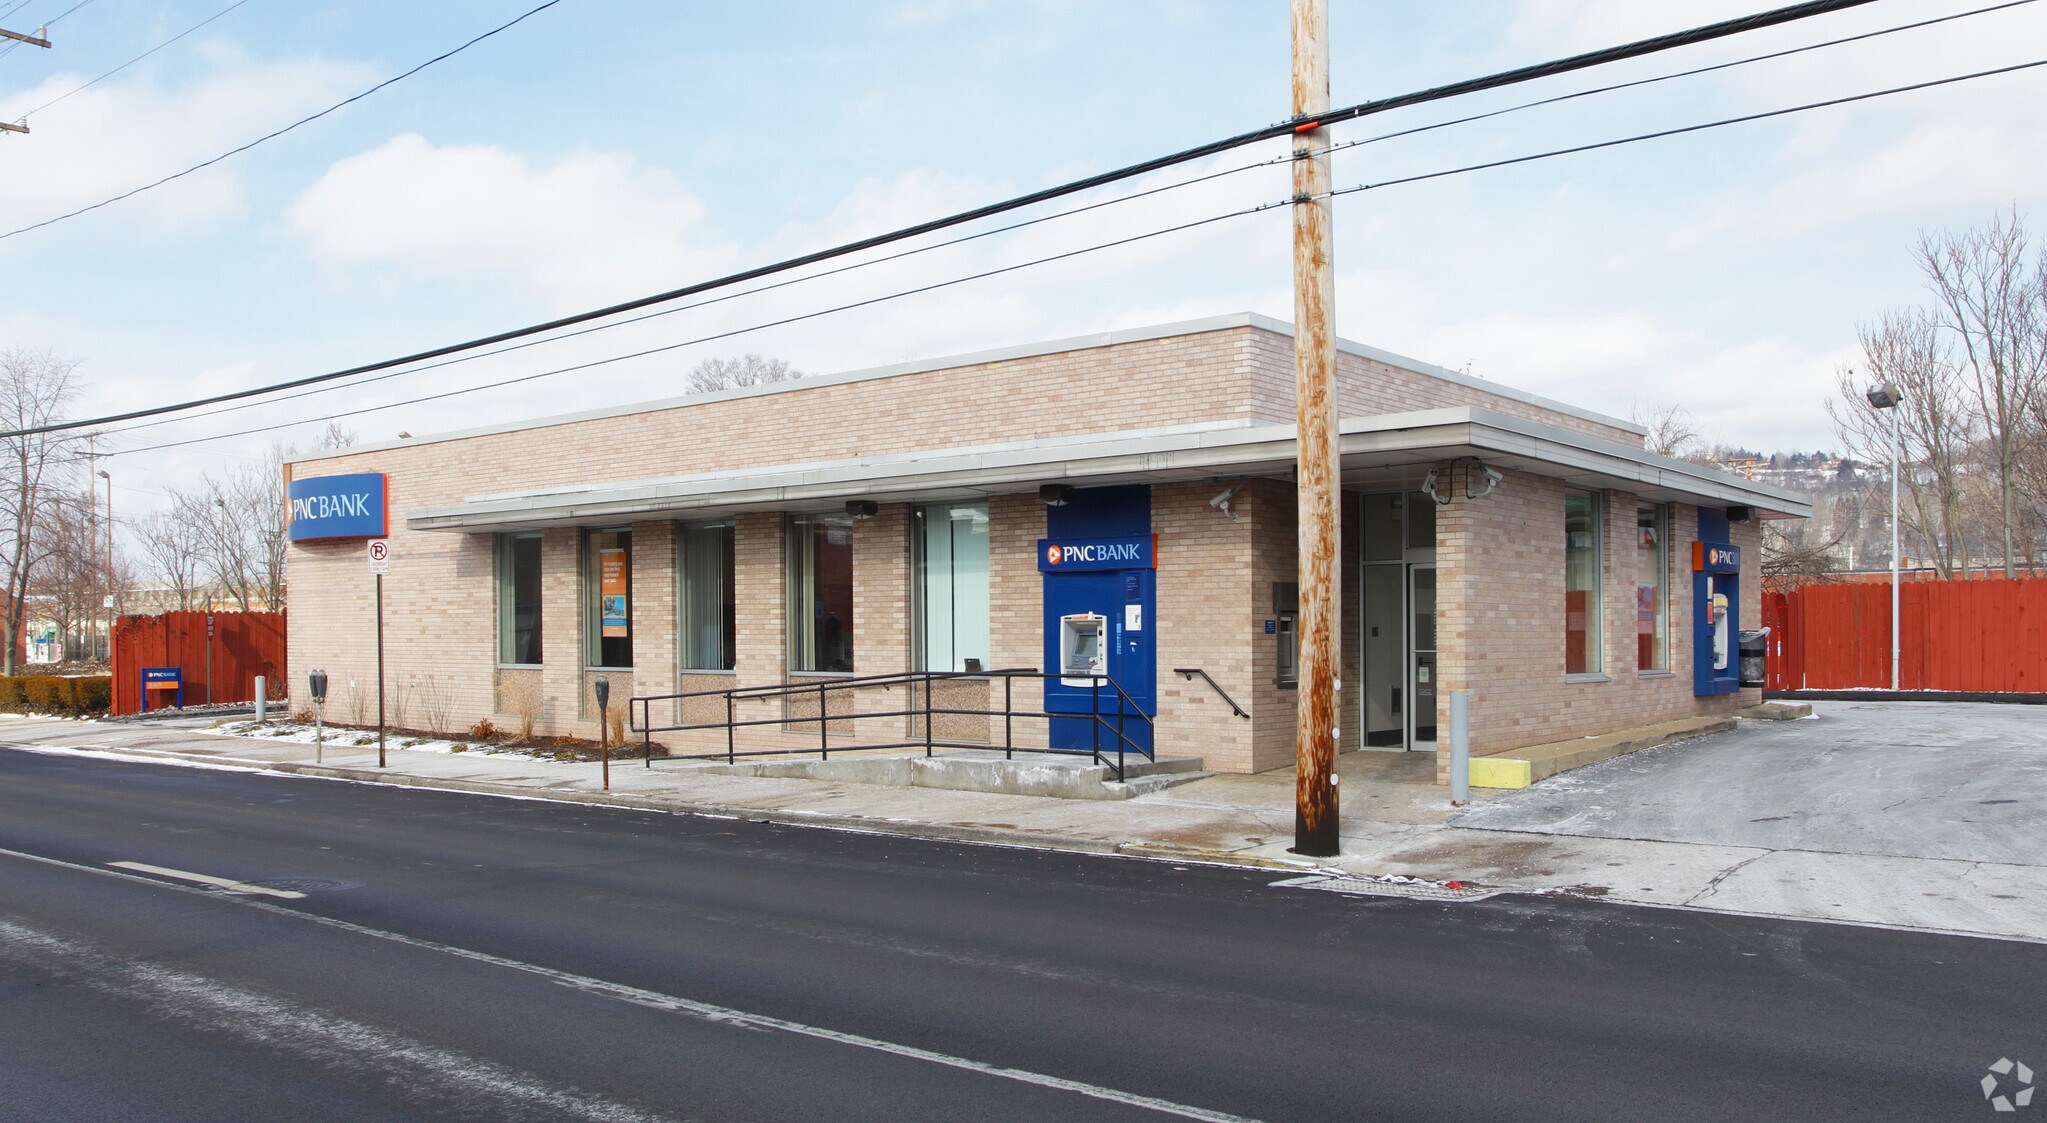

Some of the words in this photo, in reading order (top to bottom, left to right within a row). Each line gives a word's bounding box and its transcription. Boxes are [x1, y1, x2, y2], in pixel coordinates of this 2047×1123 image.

[293, 496, 317, 521] PNC
[318, 493, 370, 518] BANK
[1062, 545, 1095, 562] PNC
[1096, 543, 1140, 561] BANK
[1718, 550, 1732, 565] PNC
